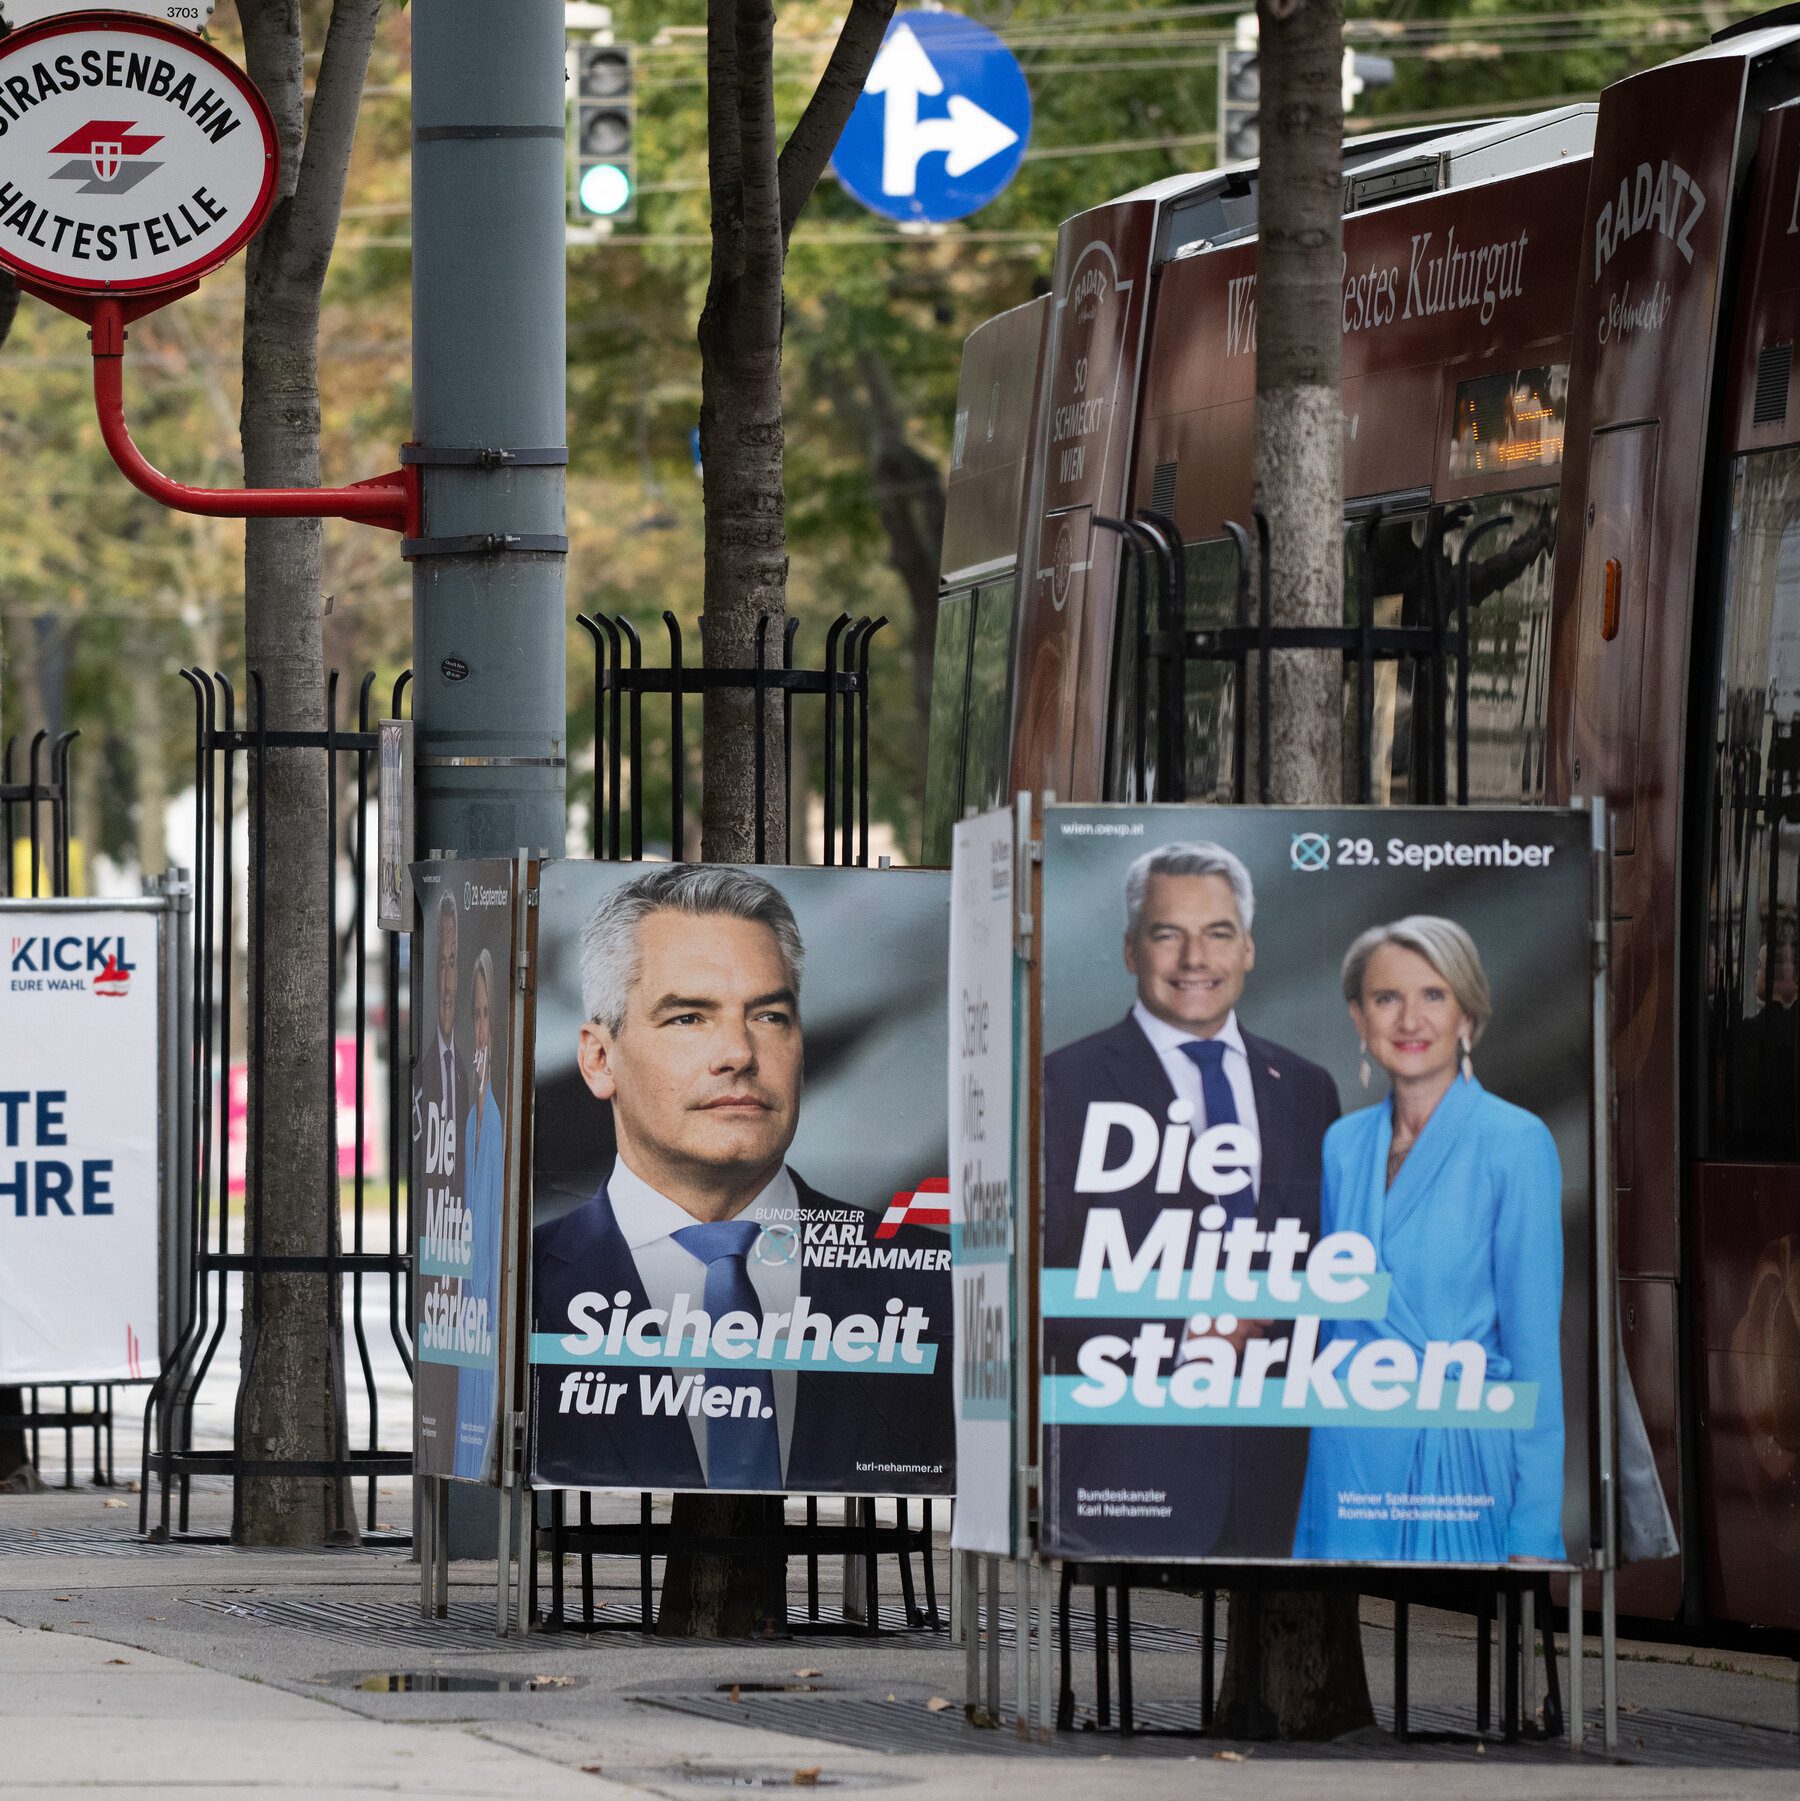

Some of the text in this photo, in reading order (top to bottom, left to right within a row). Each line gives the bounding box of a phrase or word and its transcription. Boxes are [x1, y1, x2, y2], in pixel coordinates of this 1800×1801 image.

[167, 7, 199, 18] 3703
[0, 50, 241, 144] TRASSENBAHN
[0, 181, 228, 261] HALTESTELLE
[1595, 160, 1706, 284] RADATZ
[1074, 268, 1107, 313] RADATZ
[1401, 225, 1529, 326] Kulturgut
[1073, 358, 1088, 394] SO
[1053, 397, 1104, 443] SCHMECKT
[1059, 446, 1085, 484] WIEN
[1060, 822, 1144, 837] wien.oevp.at
[1336, 838, 1555, 872] 29. September
[480, 885, 508, 910] September
[12, 936, 136, 972] KICKL
[11, 979, 86, 991] EURE WAHL
[425, 1101, 456, 1177] Die
[1074, 1099, 1261, 1196] Die
[424, 1186, 473, 1266] Mitte
[755, 1208, 865, 1223] BUNDESKANZLER
[803, 1223, 868, 1246] KARL
[803, 1246, 952, 1271] NEHAMMER
[1074, 1205, 1377, 1304] Mitte
[423, 1274, 491, 1356] stärken.
[560, 1290, 930, 1365] Sicherheit
[1071, 1313, 1515, 1413] stärken.
[558, 1371, 775, 1420] für Wien.
[856, 1461, 944, 1474] karl-nehammer.at
[1077, 1488, 1167, 1503] Bundeskanzler
[1077, 1503, 1173, 1518] Karl Nehammer
[1338, 1491, 1496, 1508] Wiener Spitzenkandidatin
[1338, 1507, 1481, 1522] Romana Deckenbacher
